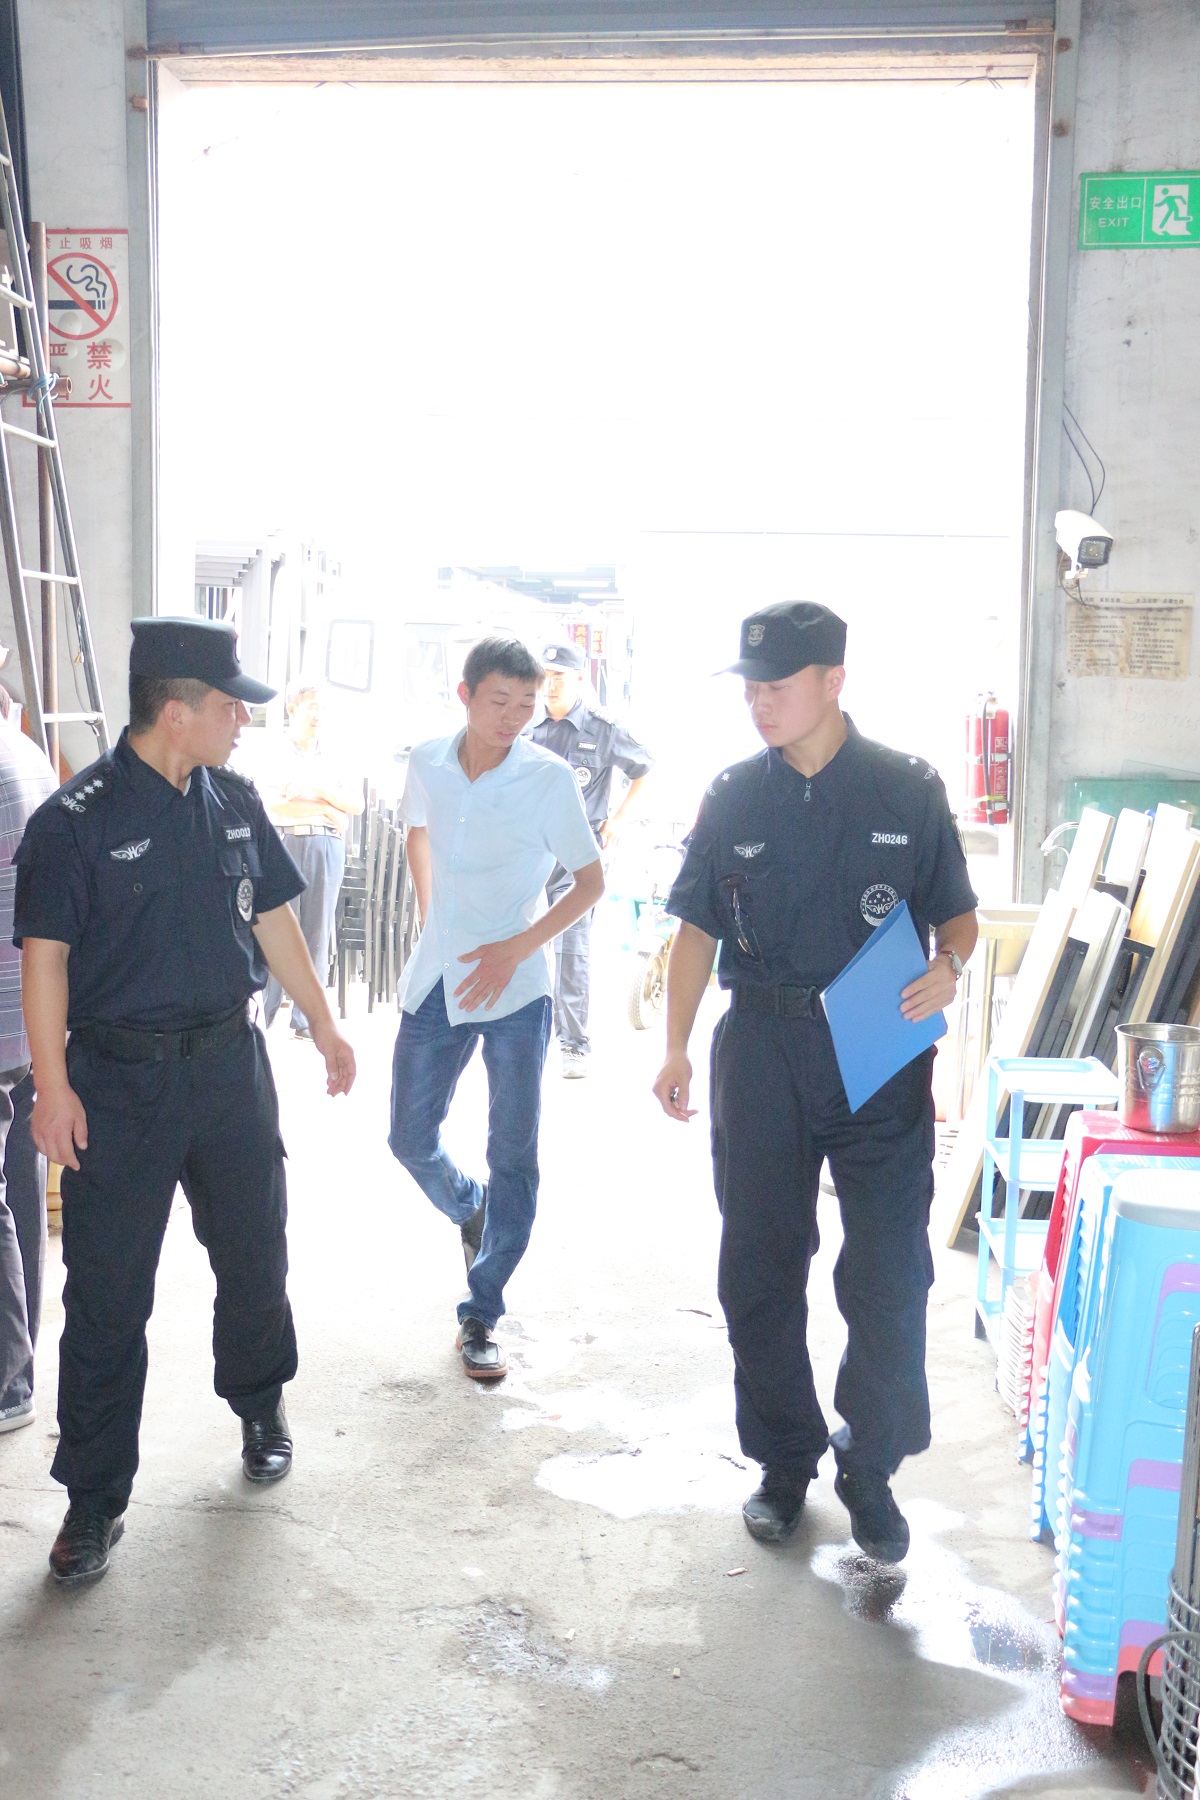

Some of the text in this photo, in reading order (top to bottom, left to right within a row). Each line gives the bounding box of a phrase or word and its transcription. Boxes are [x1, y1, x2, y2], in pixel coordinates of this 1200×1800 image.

[1089, 196, 1141, 210] 安全出口
[1098, 217, 1130, 228] EXIT
[55, 374, 114, 401] 火
[871, 832, 908, 845] ZH0246
